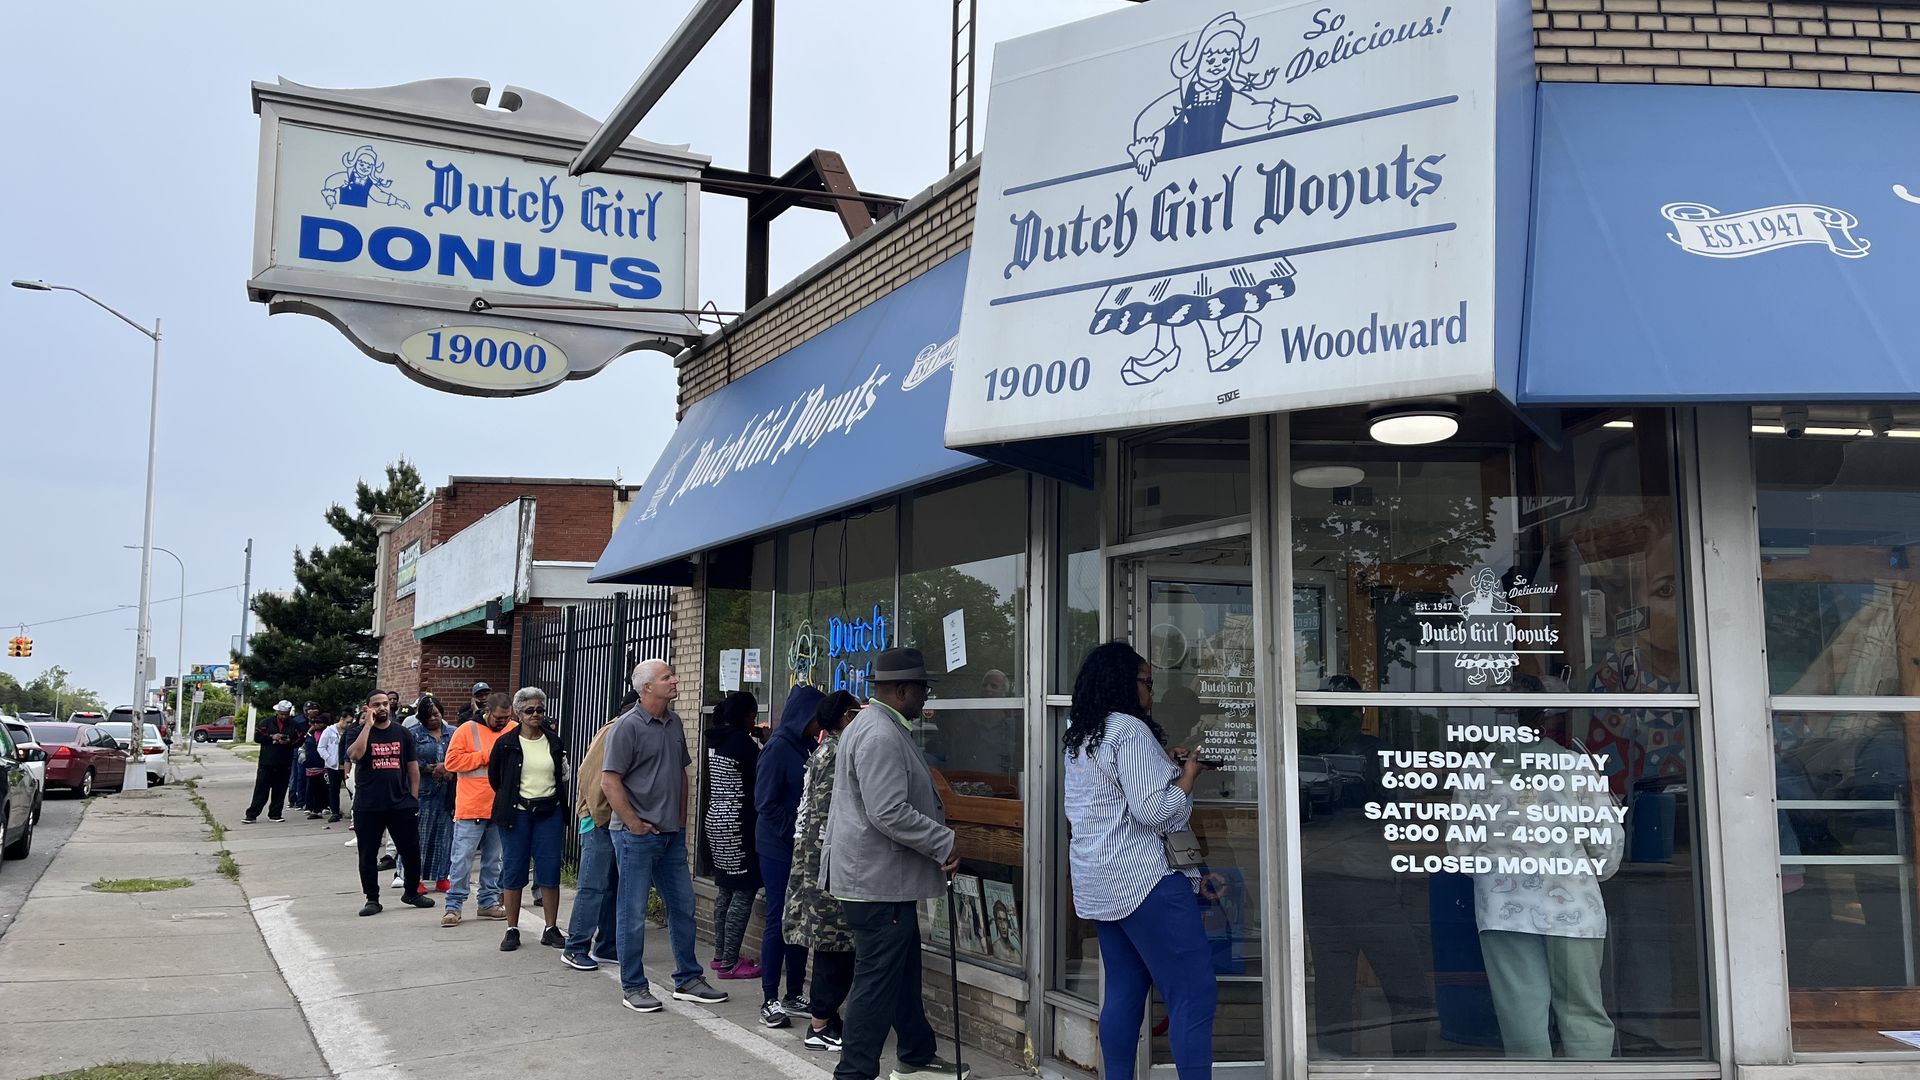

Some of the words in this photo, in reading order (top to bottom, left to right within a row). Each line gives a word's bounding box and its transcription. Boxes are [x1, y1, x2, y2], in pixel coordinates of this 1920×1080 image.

[1304, 8, 1346, 40] So
[1286, 6, 1452, 84] Delicious!
[424, 159, 565, 233] Dutch
[580, 186, 663, 242] Girl
[1003, 185, 1137, 280] Dutch
[1149, 166, 1241, 243] Girl
[1253, 145, 1447, 235] Donuts
[299, 215, 662, 300] DONUTS
[1281, 301, 1468, 364] Woodward
[425, 332, 547, 374] 19000
[983, 357, 1092, 402] 19000
[669, 414, 759, 506] Dutch
[735, 391, 806, 472] Girl
[771, 363, 891, 465] Donuts
[1508, 584, 1559, 599] Delicious!
[1513, 574, 1528, 586] So
[1415, 603, 1431, 611] Est.
[1433, 603, 1453, 611] 1947
[828, 604, 886, 657] Dutch
[1419, 621, 1467, 645] Dutch
[1470, 622, 1499, 643] Girl
[1503, 622, 1560, 645] Donuts
[437, 655, 476, 669] 19010
[1199, 679, 1226, 694] Dutch
[1228, 681, 1244, 693] Girl
[1447, 725, 1541, 743] HOURS:
[1378, 750, 1496, 769] TUESDAY
[1520, 753, 1609, 772] FRIDAY
[1381, 772, 1438, 790] 6:00
[1444, 773, 1485, 790] AM
[1509, 774, 1566, 792] 6:00
[1571, 775, 1609, 792] PM
[1364, 802, 1501, 821] SATURDAY
[1526, 805, 1629, 824] SUNDAY
[1383, 824, 1439, 842] 8:00
[1445, 825, 1487, 842] AM
[1511, 826, 1568, 844] 4:00
[1573, 828, 1612, 845] PM
[1390, 855, 1492, 874] CLOSED
[1498, 857, 1607, 876] MONDAY
